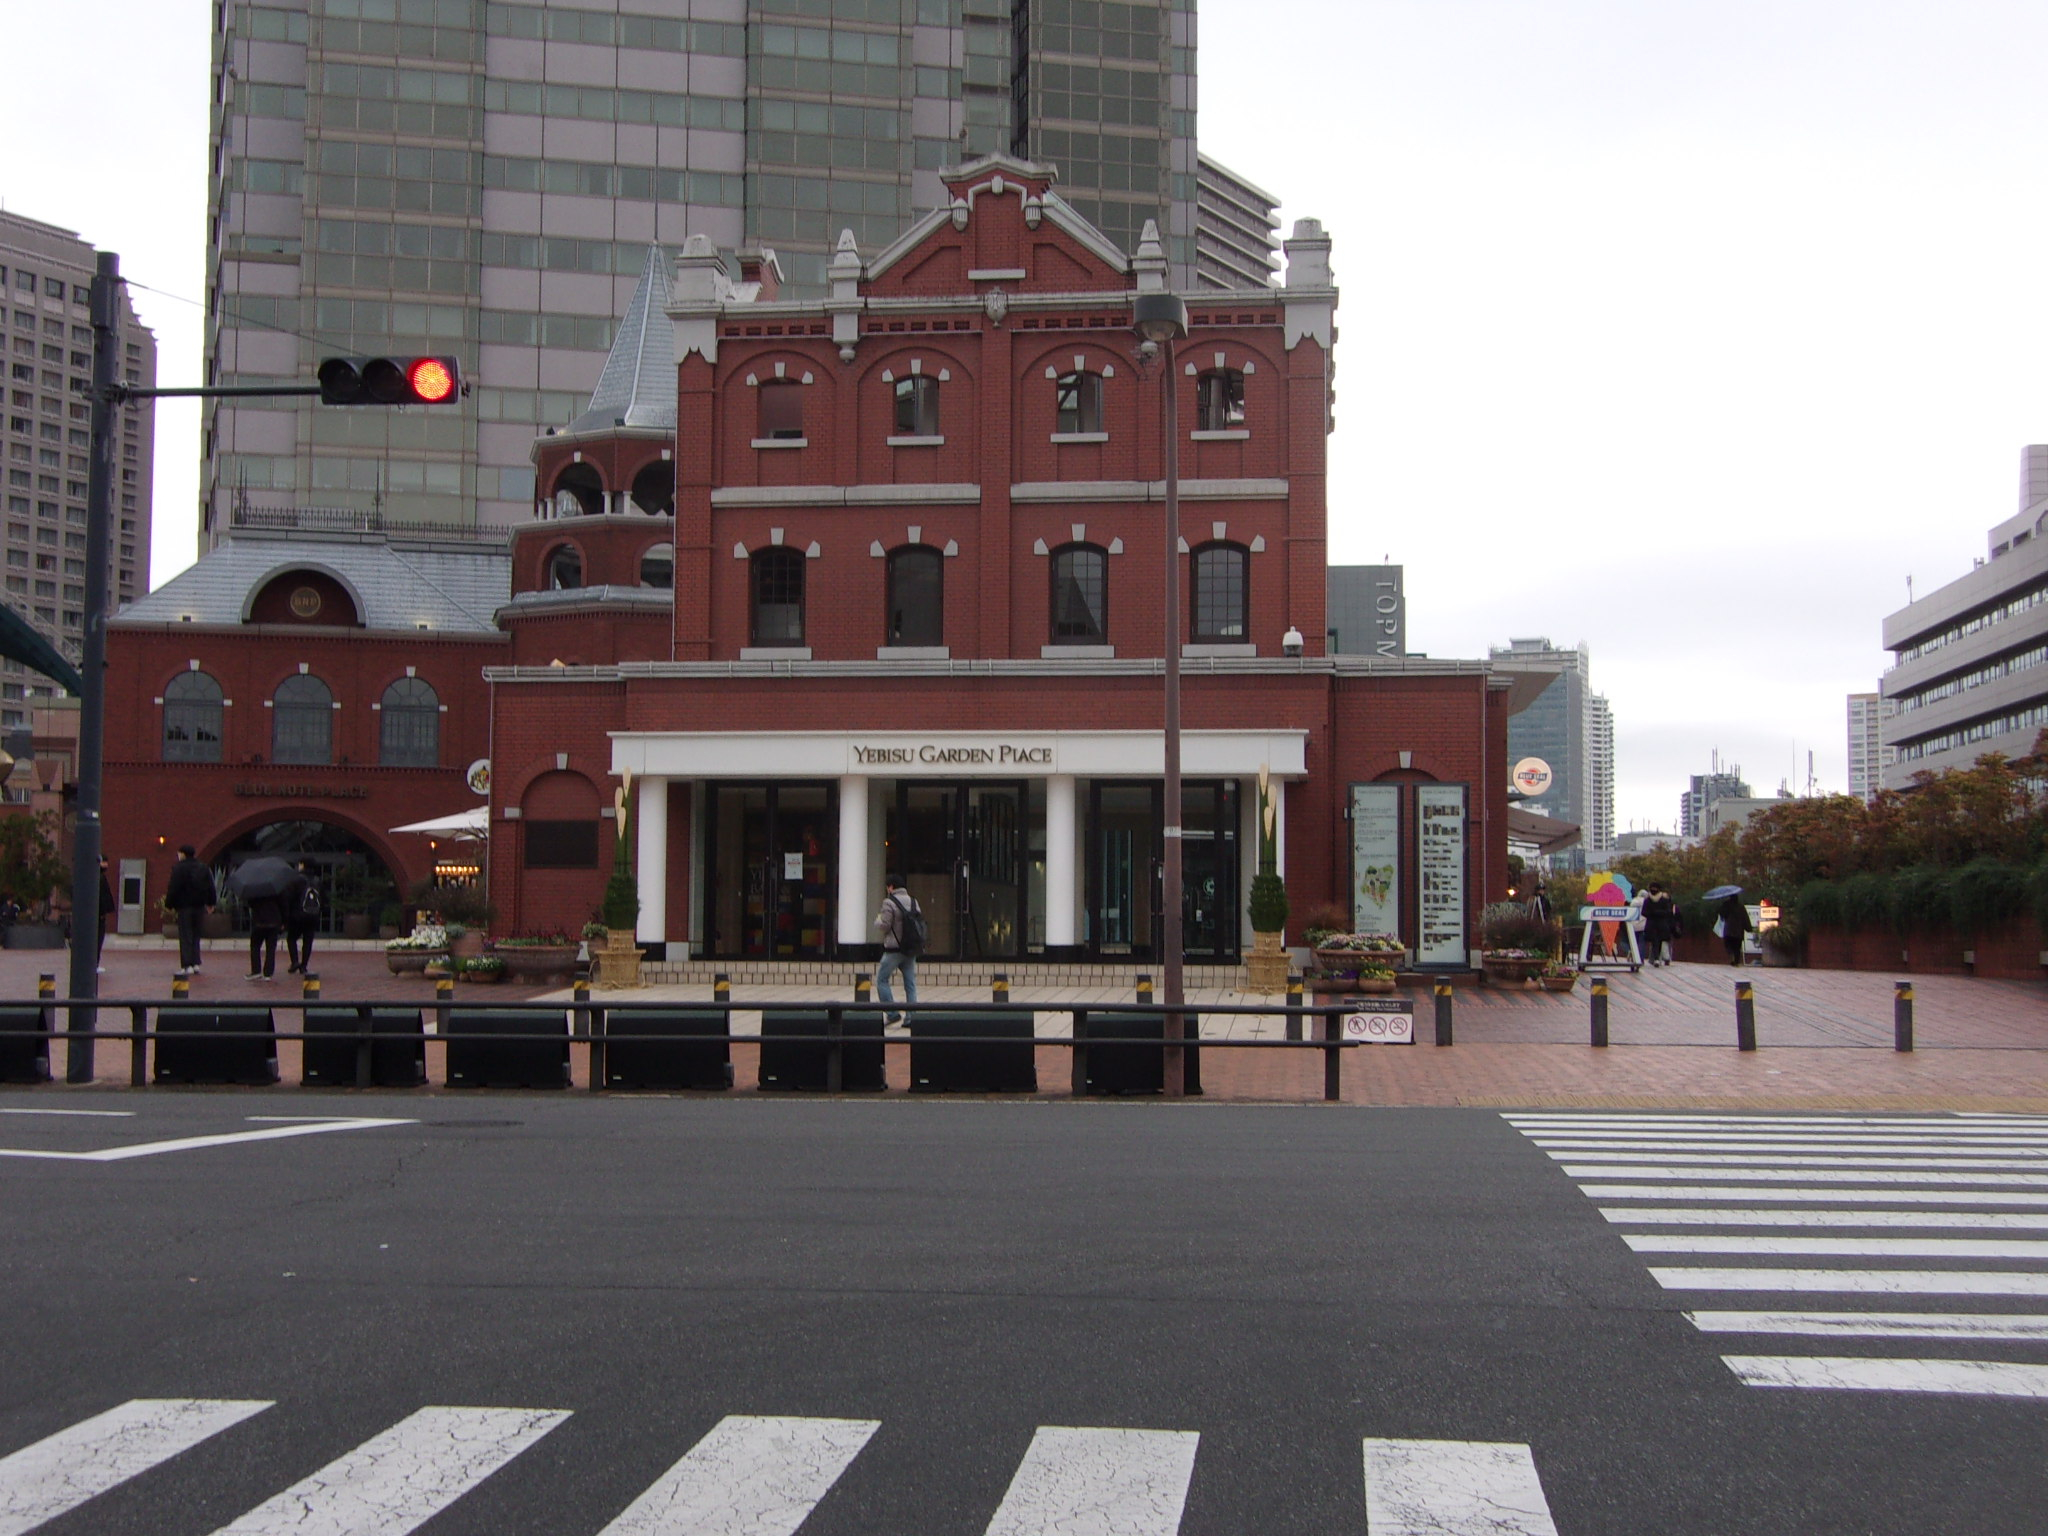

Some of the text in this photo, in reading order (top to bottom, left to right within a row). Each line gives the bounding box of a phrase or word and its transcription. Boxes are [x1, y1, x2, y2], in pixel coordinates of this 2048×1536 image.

[853, 746, 1052, 763] YEBISU GARDEN PLACE
[234, 783, 369, 798] BLUE NOTE PLACE
[1594, 909, 1625, 917] BLUE SEAL
